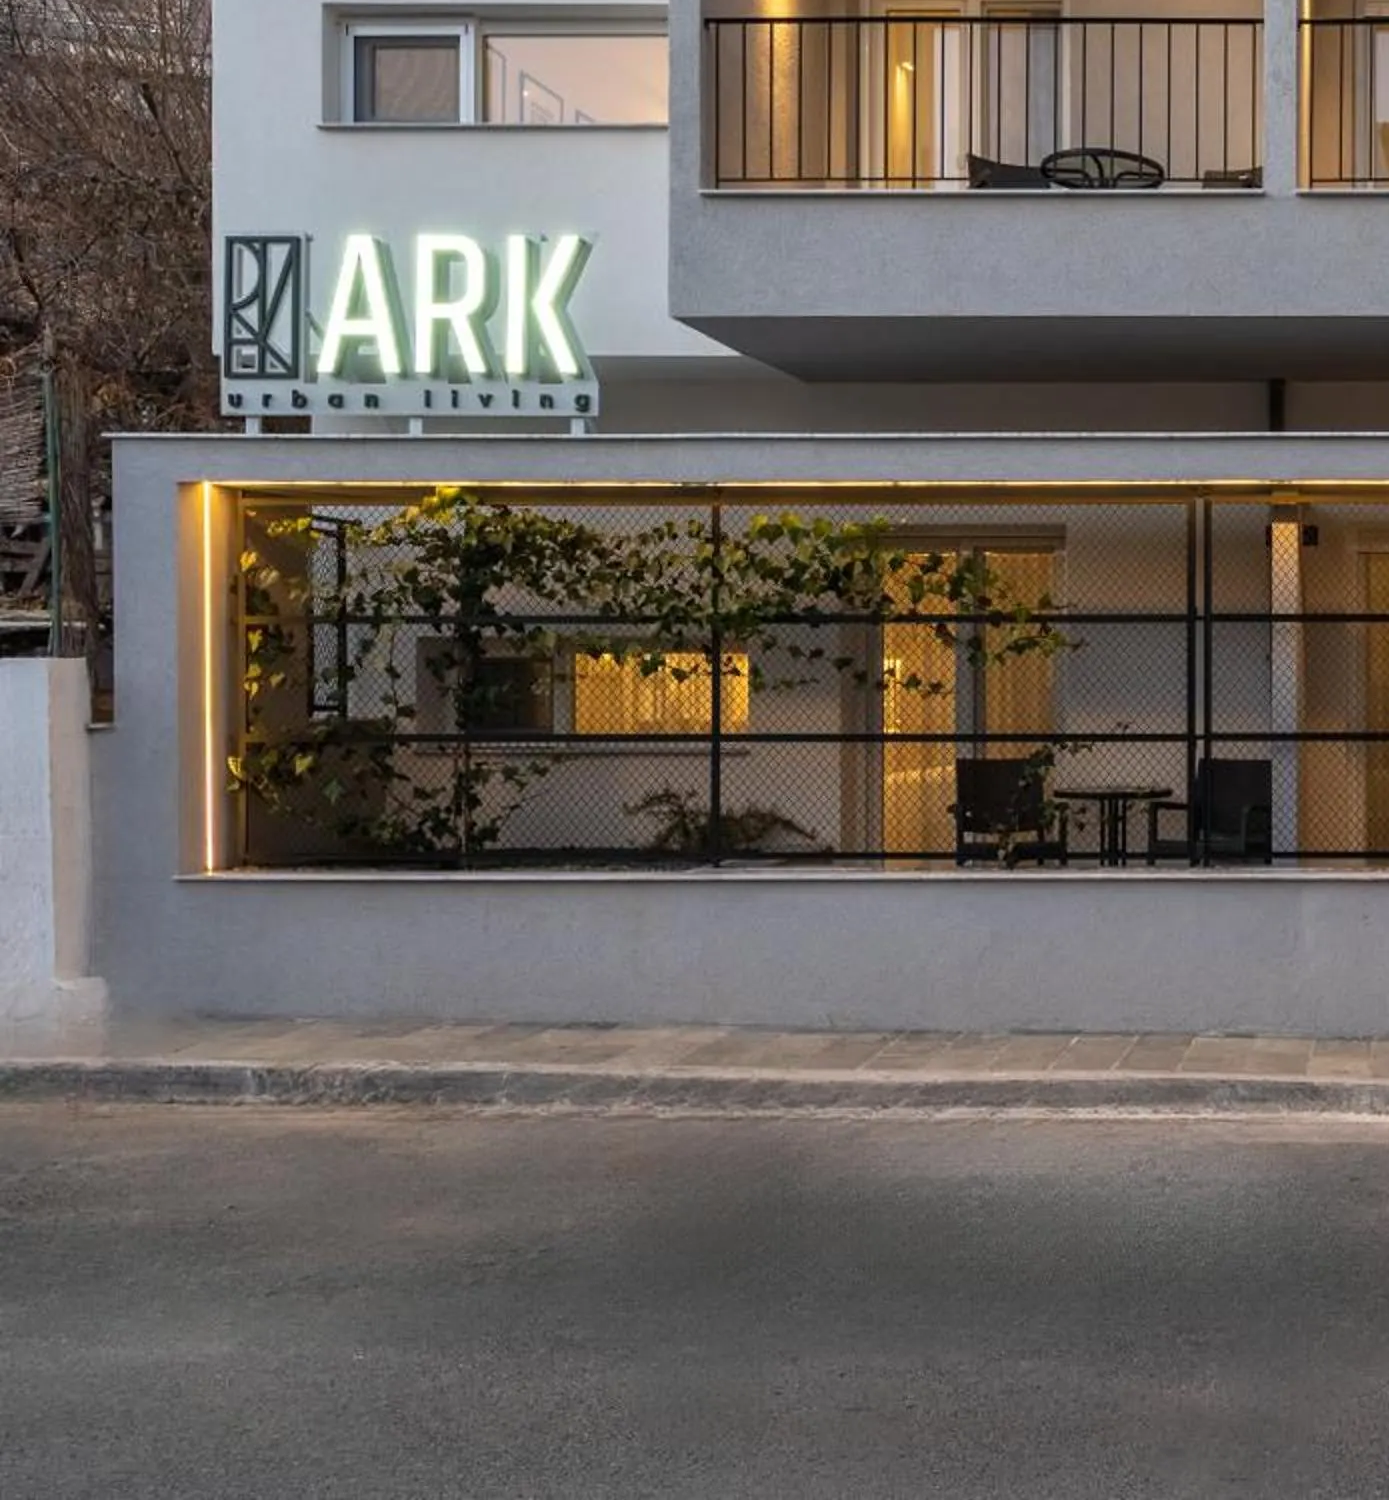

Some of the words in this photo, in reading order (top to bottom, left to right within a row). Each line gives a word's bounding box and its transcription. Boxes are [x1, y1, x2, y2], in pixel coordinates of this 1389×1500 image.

[316, 234, 585, 376] ARK
[227, 389, 380, 410] urban
[424, 389, 592, 413] living
